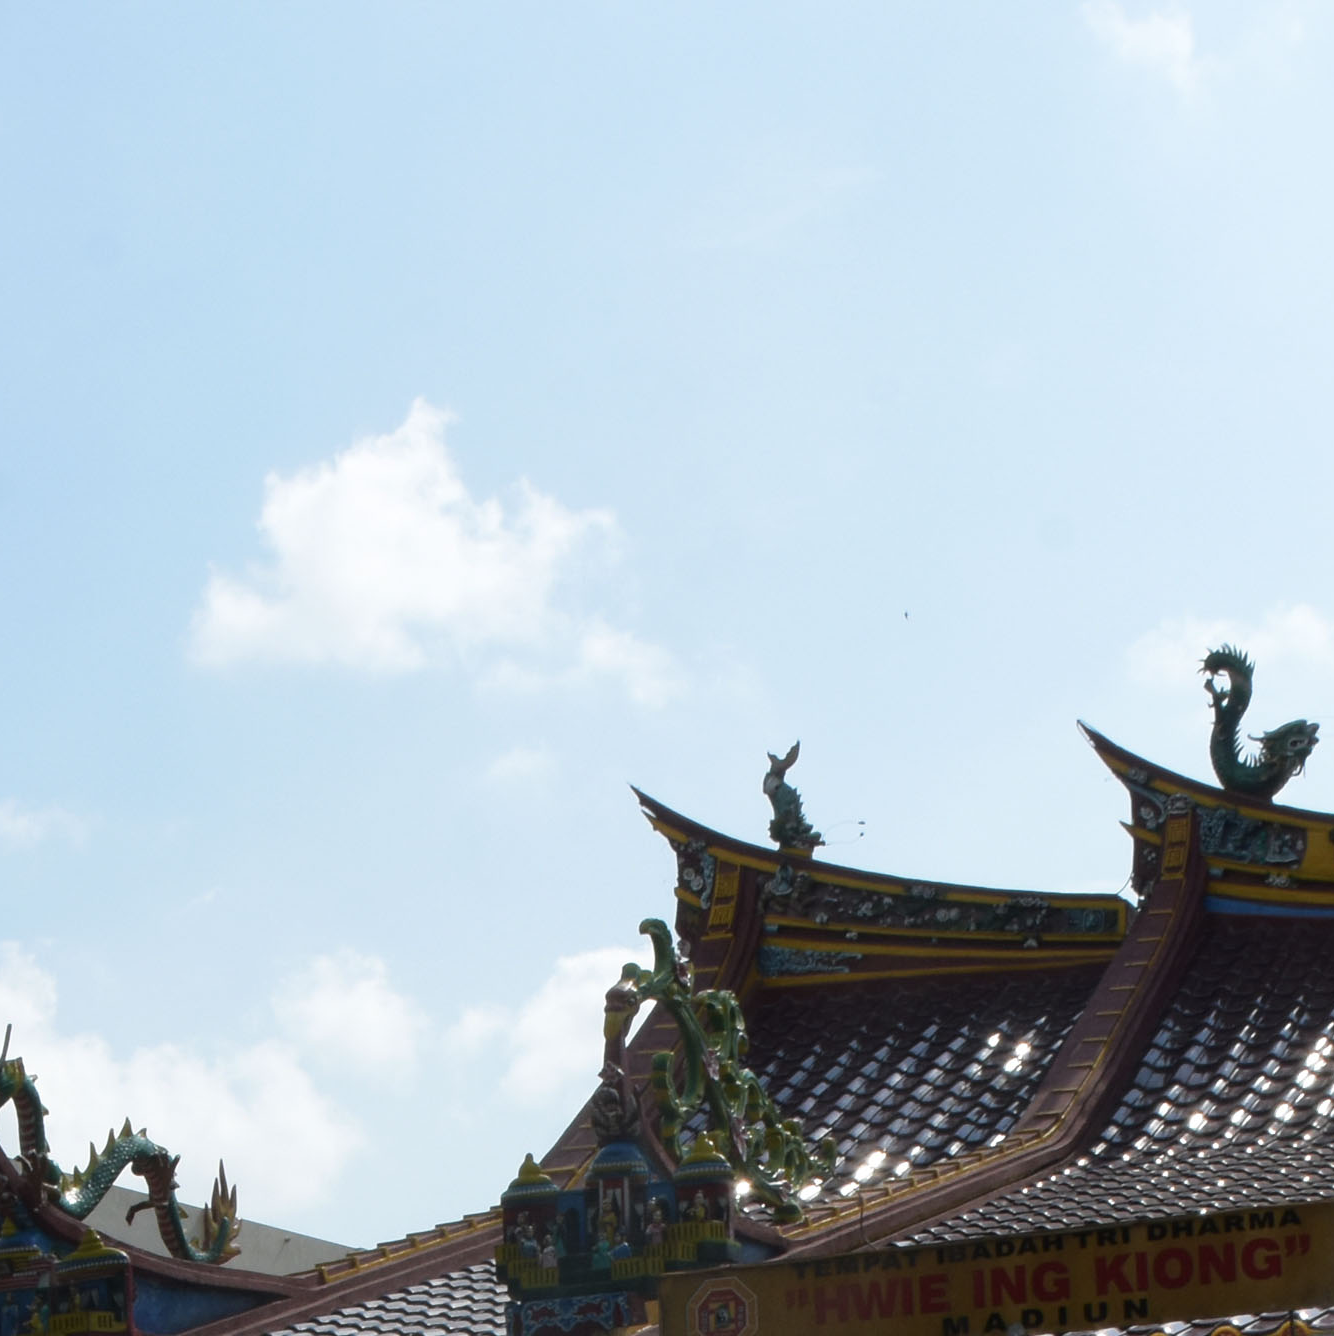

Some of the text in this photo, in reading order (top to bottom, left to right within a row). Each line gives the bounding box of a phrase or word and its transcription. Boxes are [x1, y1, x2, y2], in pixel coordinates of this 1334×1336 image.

[790, 1208, 1302, 1280] TEMPAT IBADAH TRI DHARMA
[971, 1260, 1072, 1310] ING
